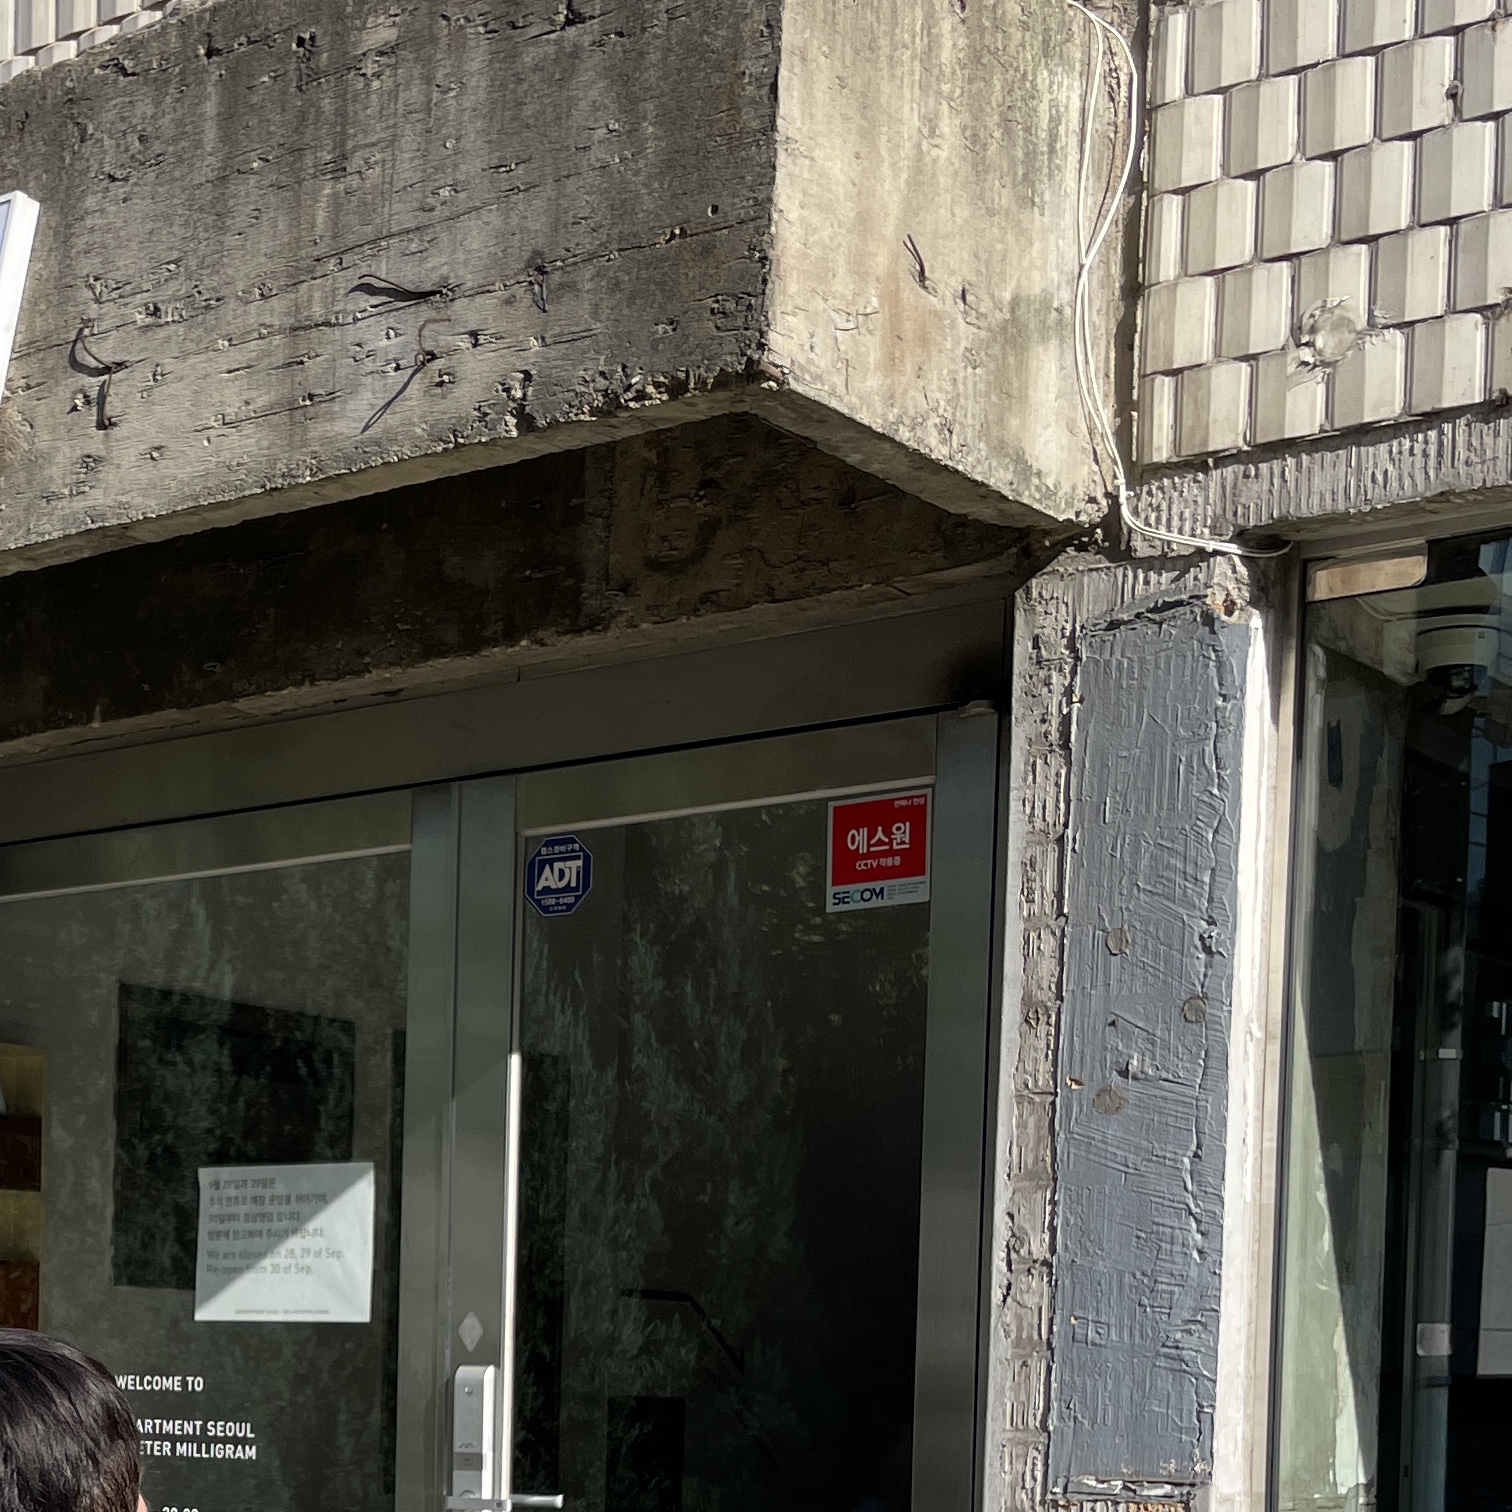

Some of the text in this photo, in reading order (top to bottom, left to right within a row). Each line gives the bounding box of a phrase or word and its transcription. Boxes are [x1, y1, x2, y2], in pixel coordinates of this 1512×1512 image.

[847, 821, 910, 854] 에스원
[856, 858, 878, 871] CCTV
[536, 860, 583, 891] ADT
[832, 886, 885, 906] SECOM
[313, 1248, 322, 1259] of
[270, 1263, 281, 1274] 30
[283, 1263, 292, 1274] of
[115, 1375, 204, 1392] WELCOME TO
[136, 1418, 255, 1438] ARTMENT SEOUL
[139, 1440, 257, 1460] ETER MILLIGRAM
